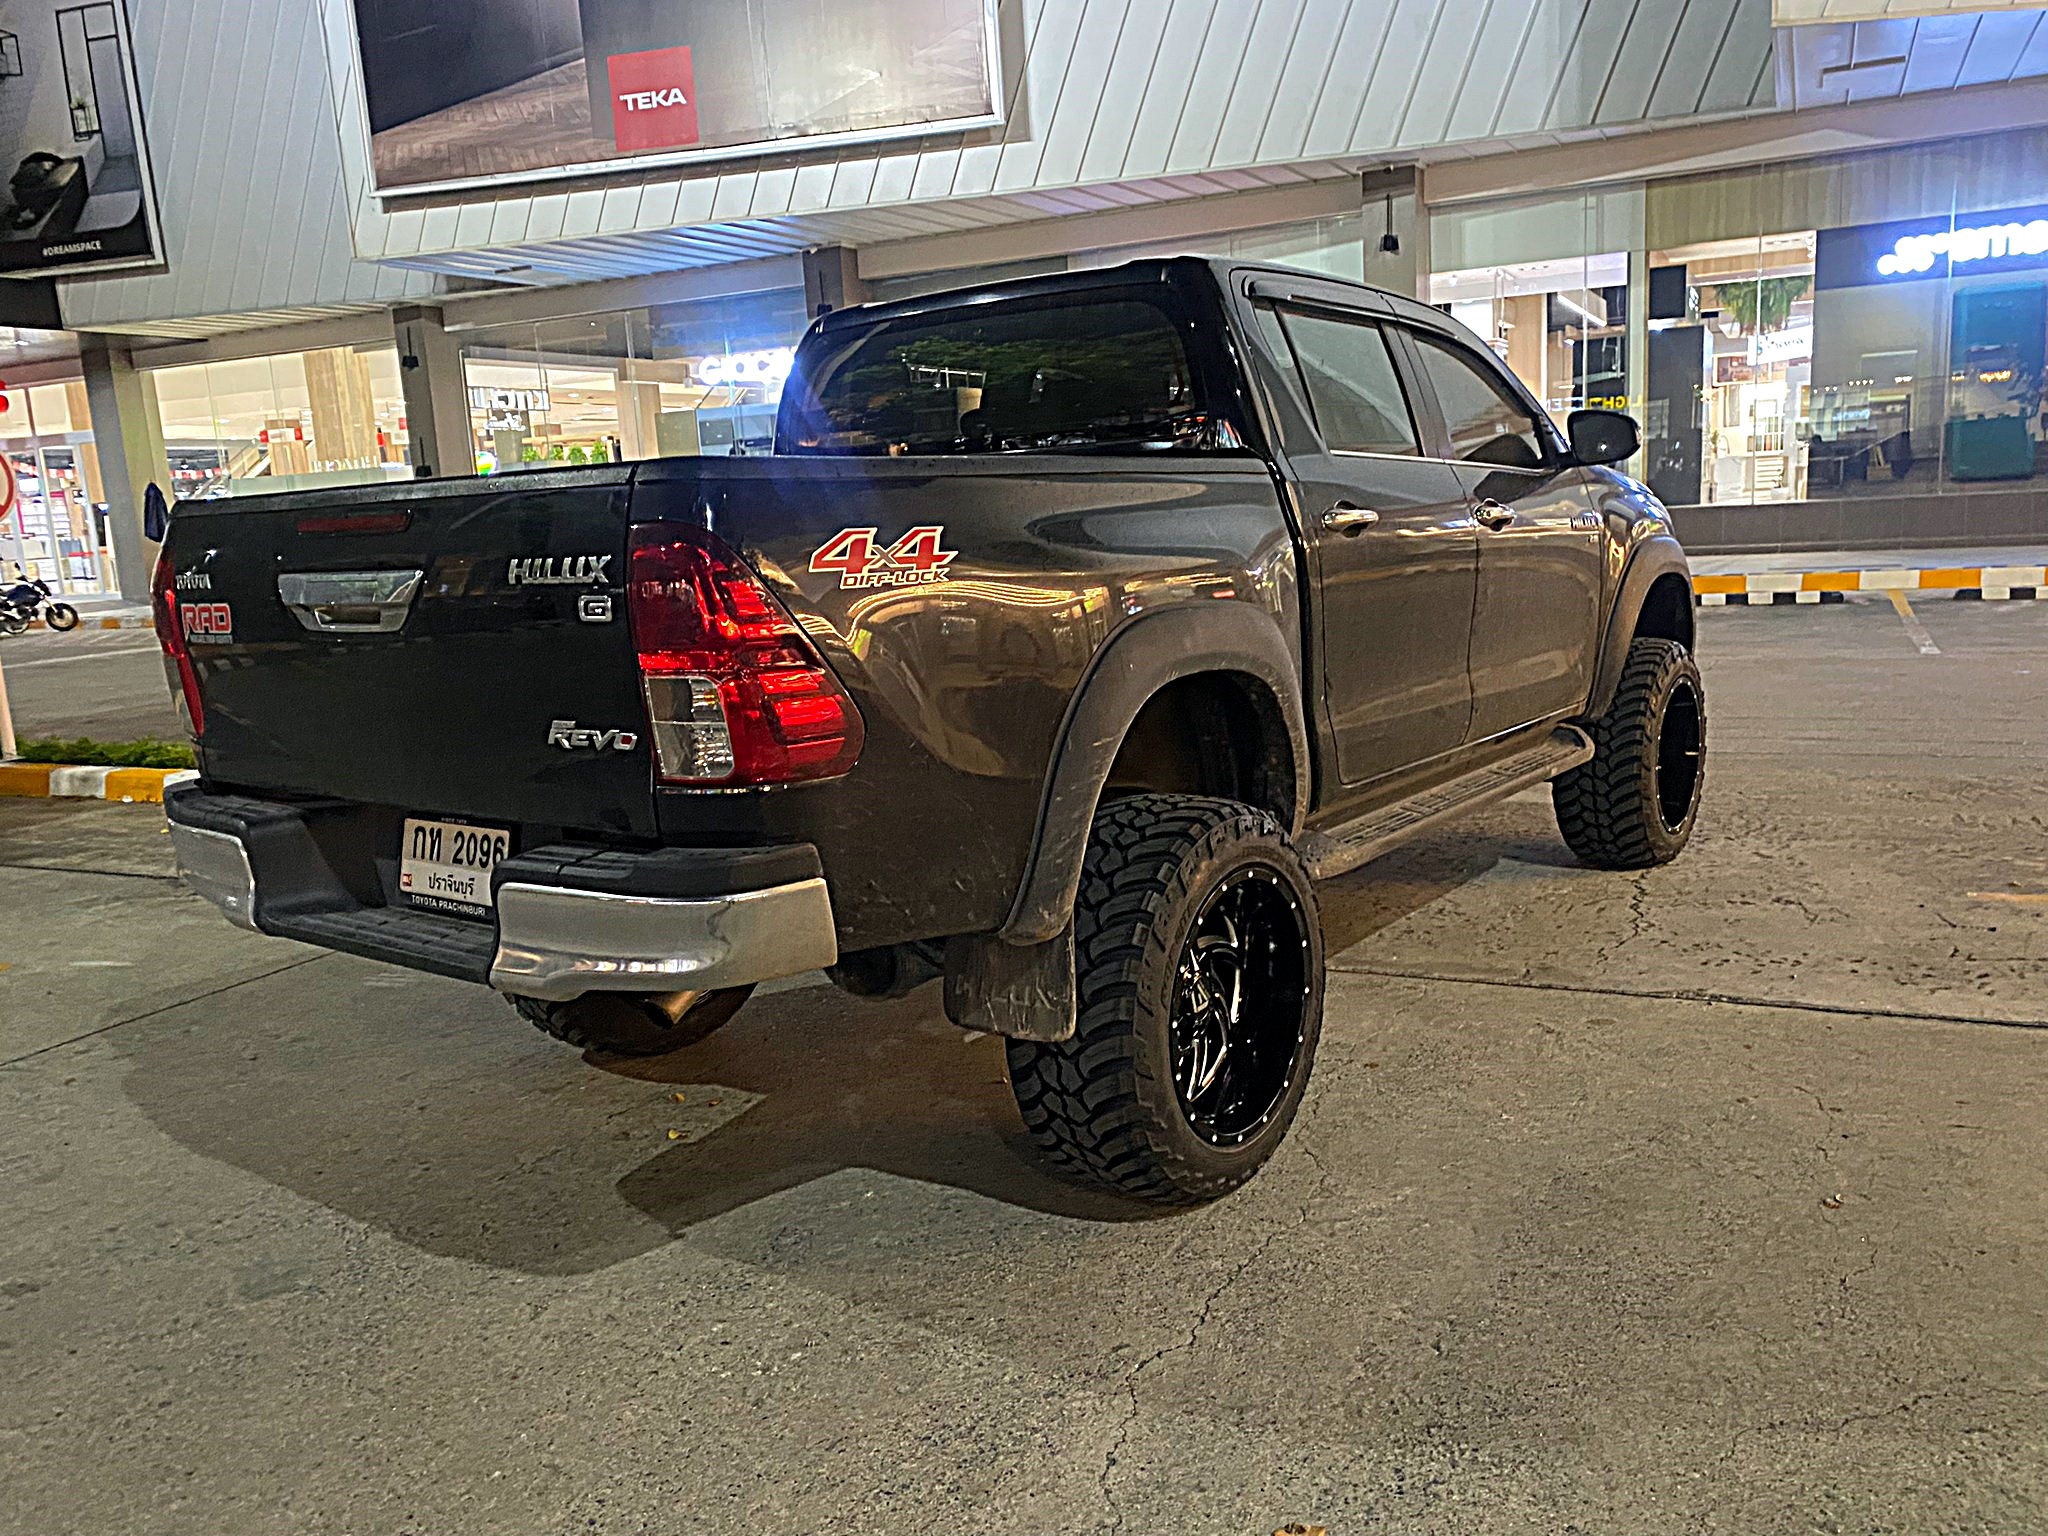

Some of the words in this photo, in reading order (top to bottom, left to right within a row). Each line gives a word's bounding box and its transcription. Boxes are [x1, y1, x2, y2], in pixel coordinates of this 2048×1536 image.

[619, 87, 687, 111] TEKA
[508, 554, 612, 585] HILUX
[840, 568, 951, 590] DIFF-LOCK
[578, 595, 613, 622] G
[452, 830, 506, 869] 2096
[428, 872, 475, 899] ปราจีนบุรี
[411, 894, 437, 907] TOYOTA
[438, 899, 486, 917] PRACHINBURI
